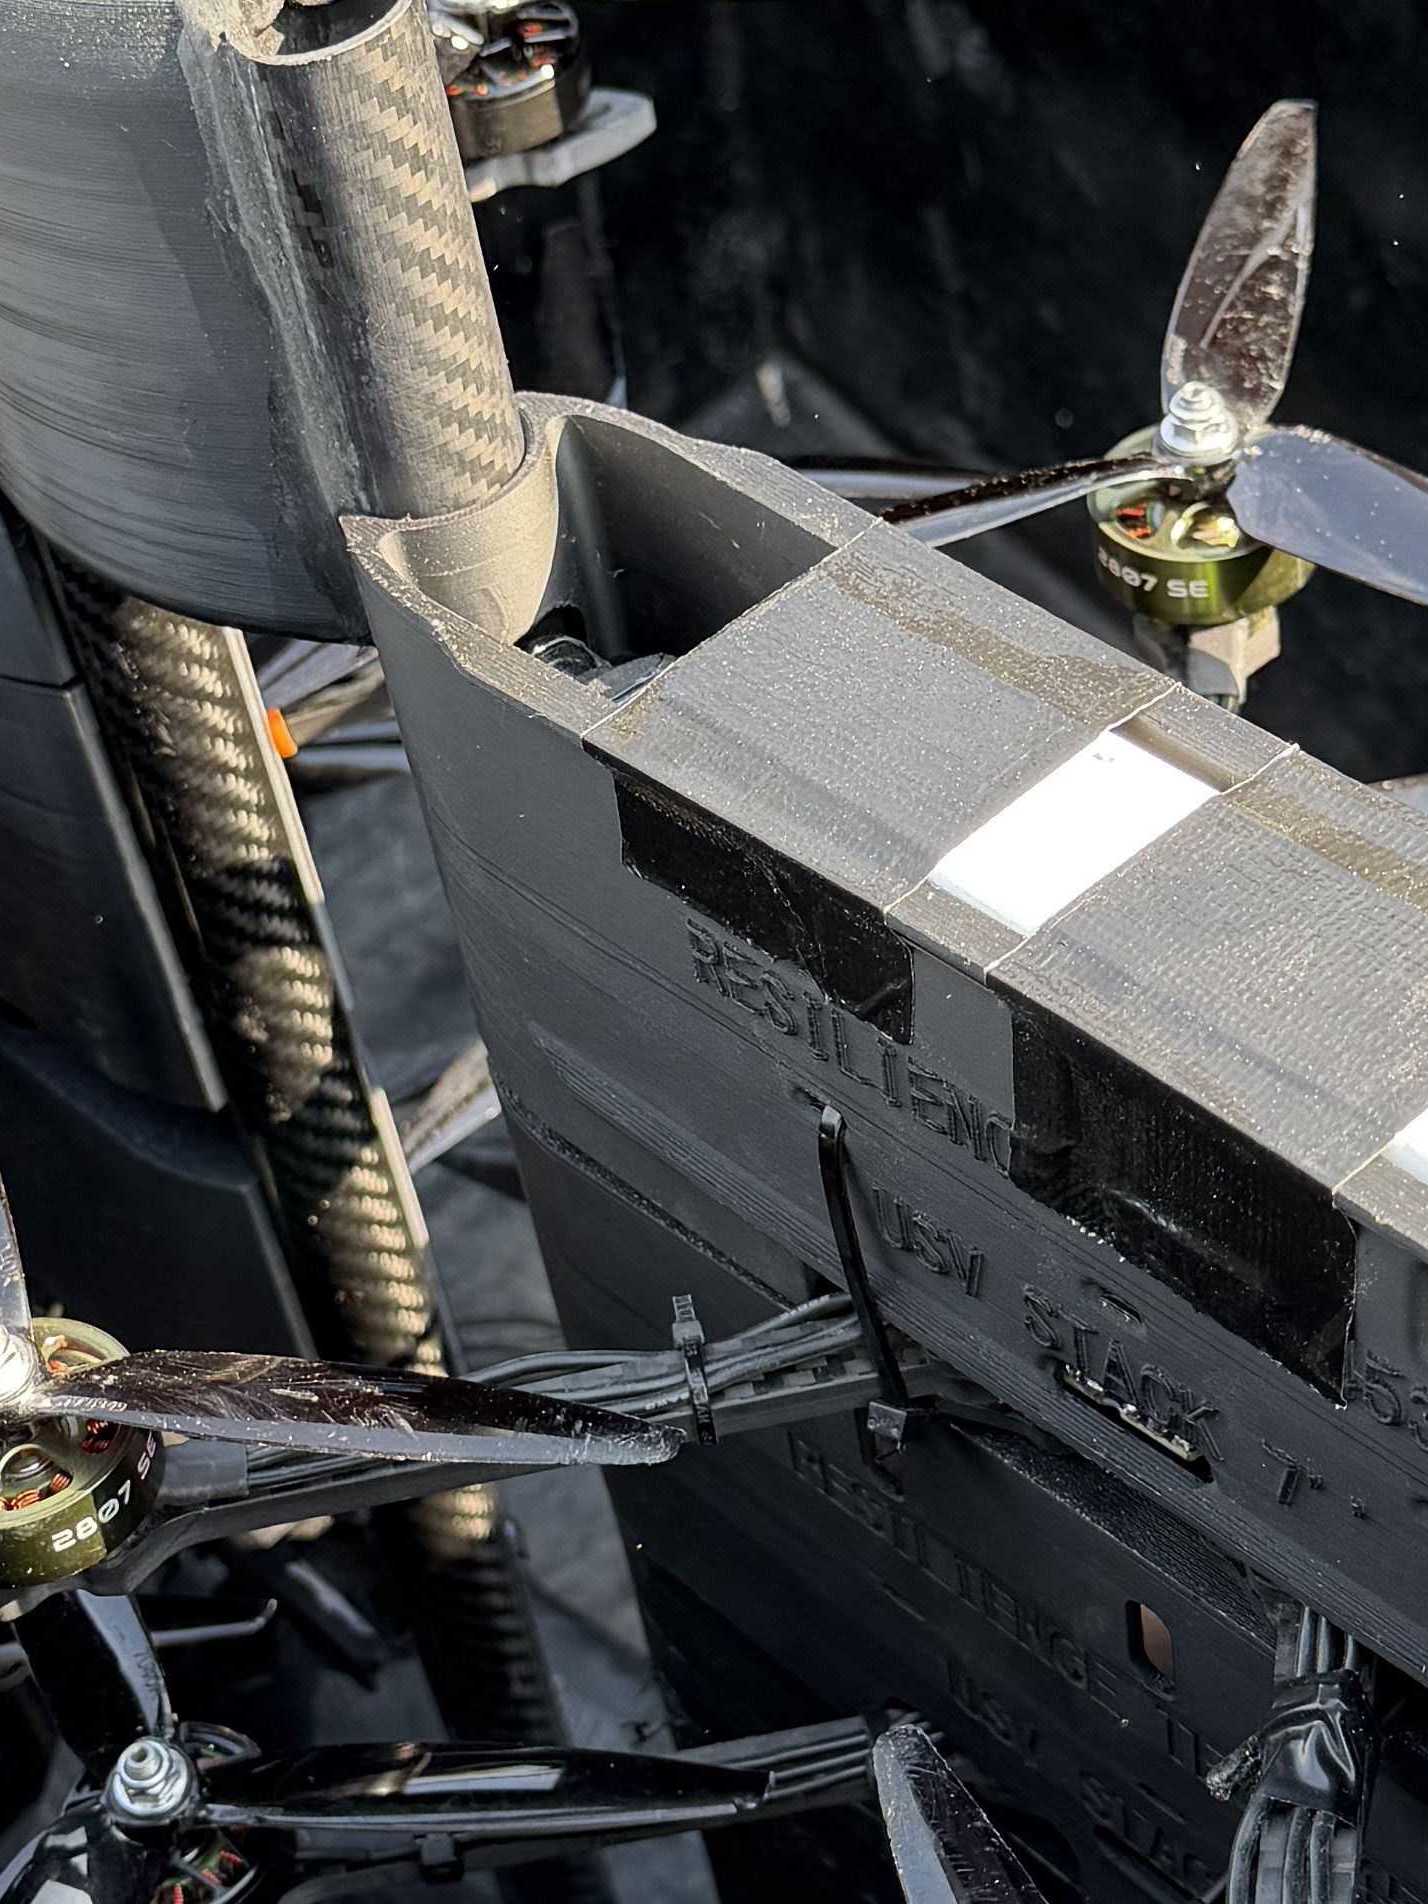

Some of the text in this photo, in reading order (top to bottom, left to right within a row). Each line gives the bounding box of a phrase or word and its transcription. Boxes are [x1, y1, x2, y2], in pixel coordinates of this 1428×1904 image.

[1167, 578, 1209, 599] SE
[685, 914, 1014, 1179] RESILIENC
[871, 1185, 985, 1297] USV
[1023, 1284, 1225, 1463] STACK
[51, 1479, 132, 1553] 2807
